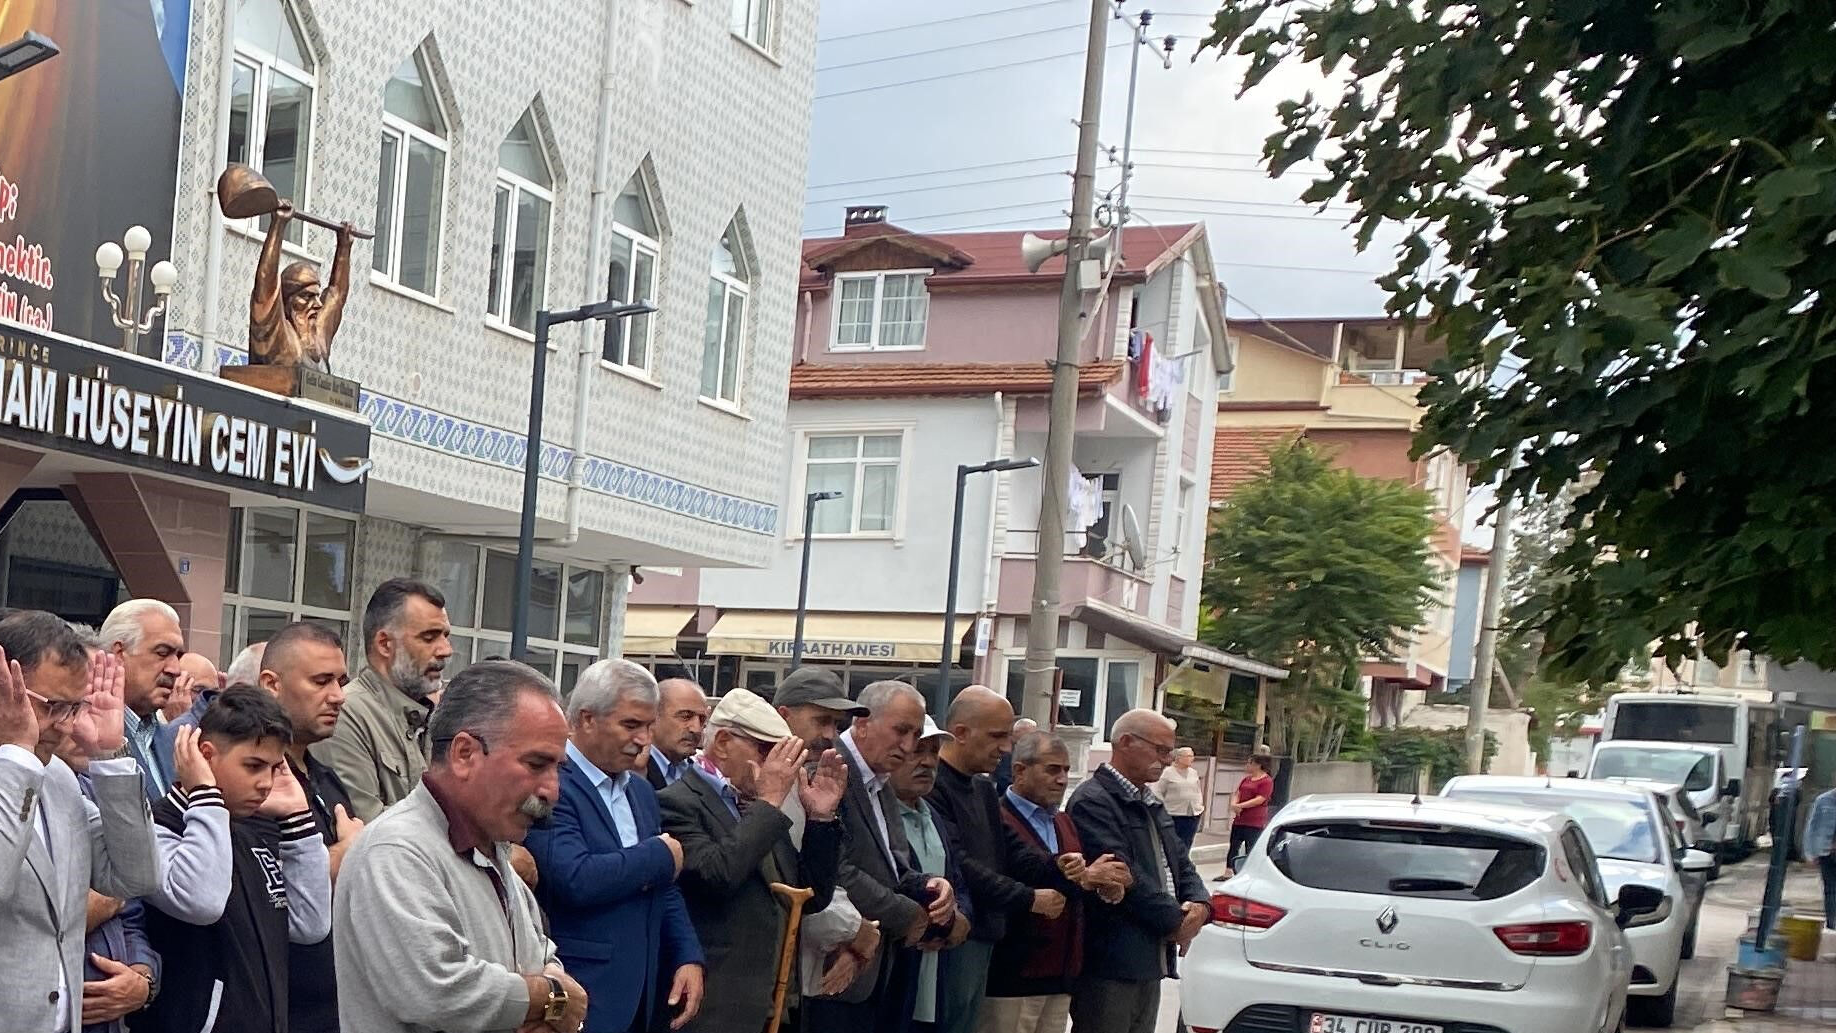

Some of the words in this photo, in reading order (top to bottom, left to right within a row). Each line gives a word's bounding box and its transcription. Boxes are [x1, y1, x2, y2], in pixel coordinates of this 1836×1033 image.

[65, 364, 204, 467] HÜSEYİN
[211, 413, 268, 480] CEM
[273, 419, 317, 491] EVİ
[1359, 938, 1411, 951] CLIO
